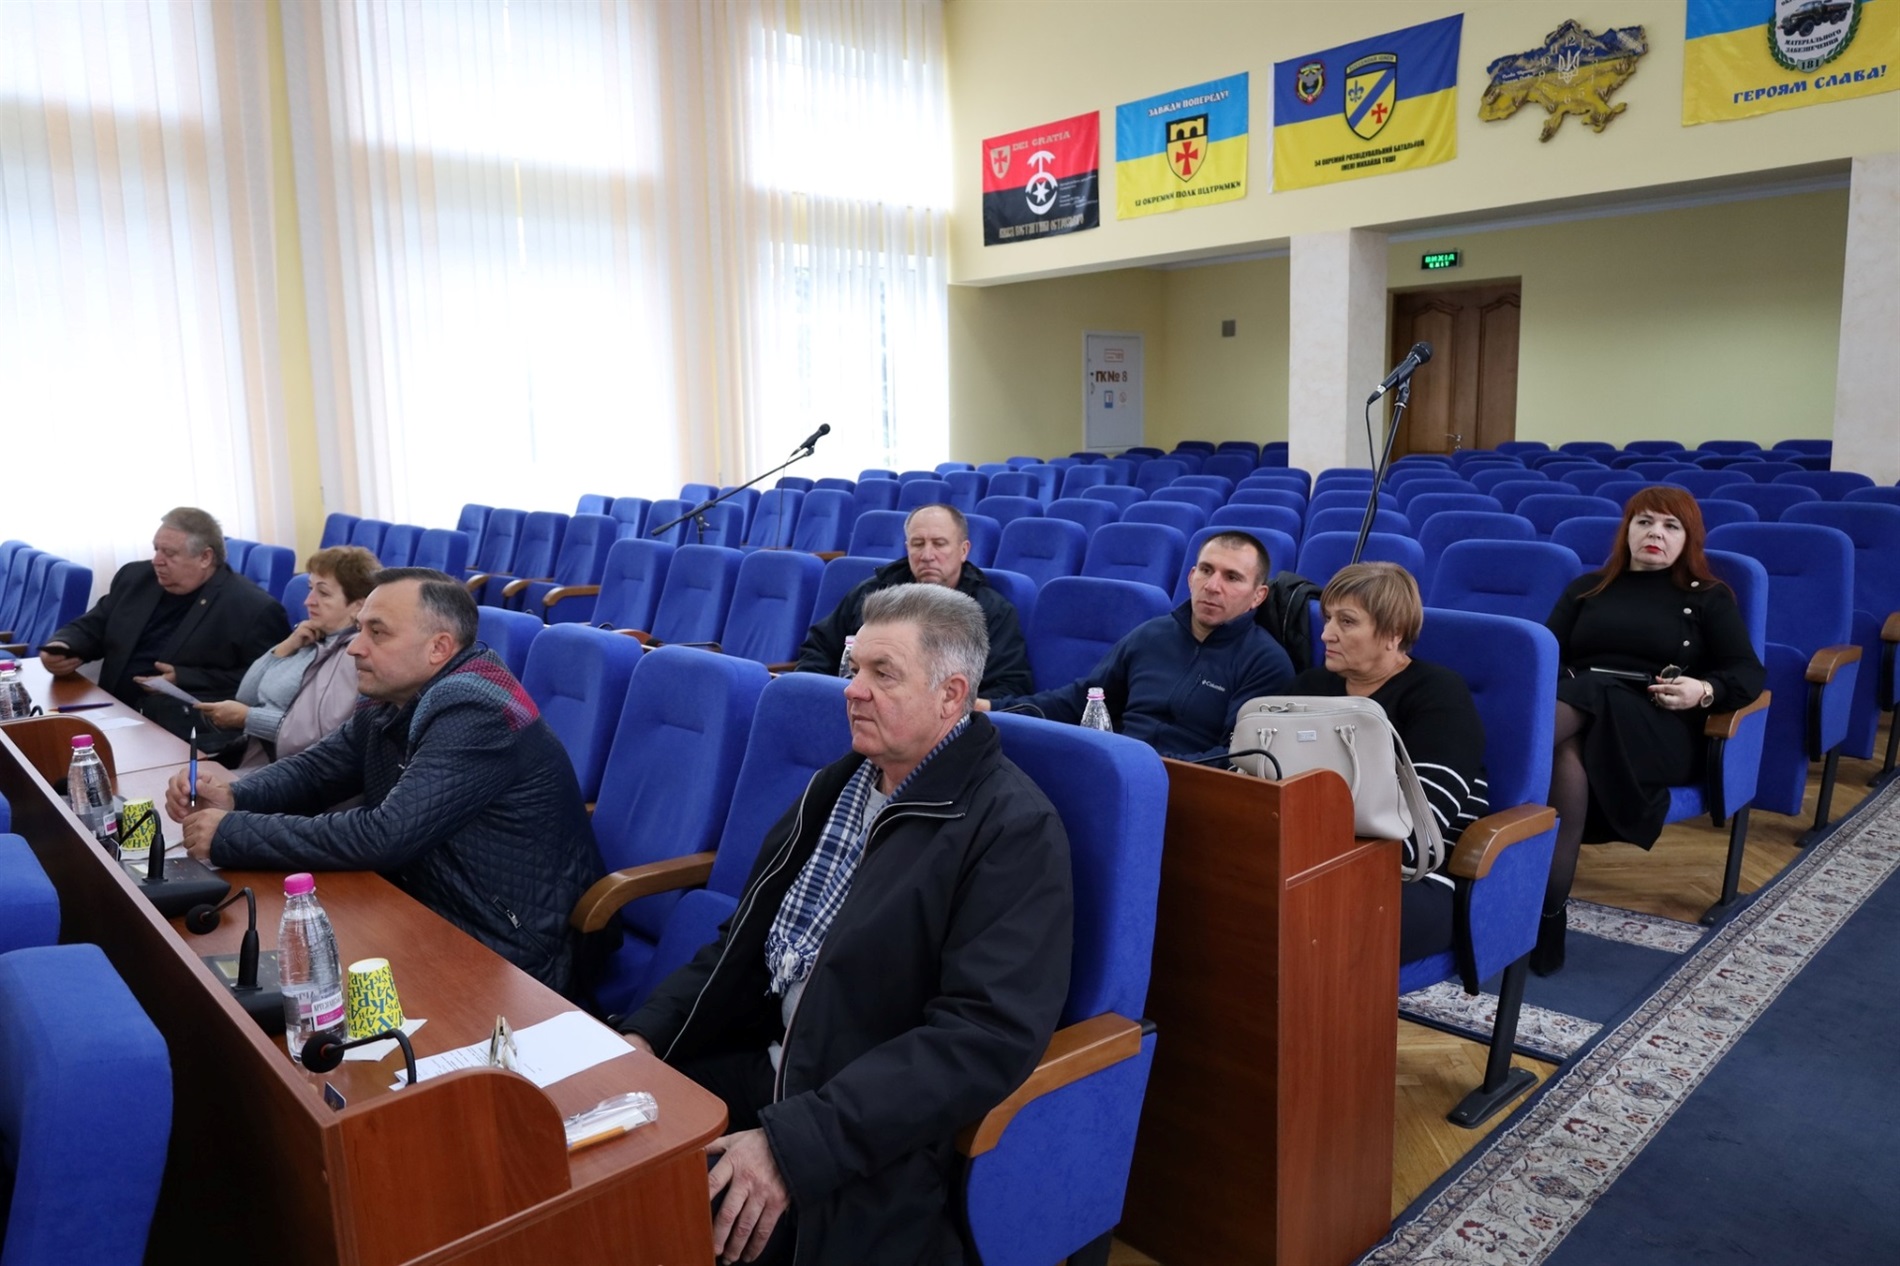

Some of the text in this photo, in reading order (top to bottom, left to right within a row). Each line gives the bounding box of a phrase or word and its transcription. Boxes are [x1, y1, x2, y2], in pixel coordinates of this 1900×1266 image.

[1784, 28, 1842, 46] МАТЕРІАЛЬНОГО
[1801, 59, 1820, 70] 181
[1733, 64, 1888, 104] ГЕРОЯМ СЛАВА!
[1012, 131, 1071, 151] DEI GRATIA
[1175, 188, 1196, 199] ПОЛК
